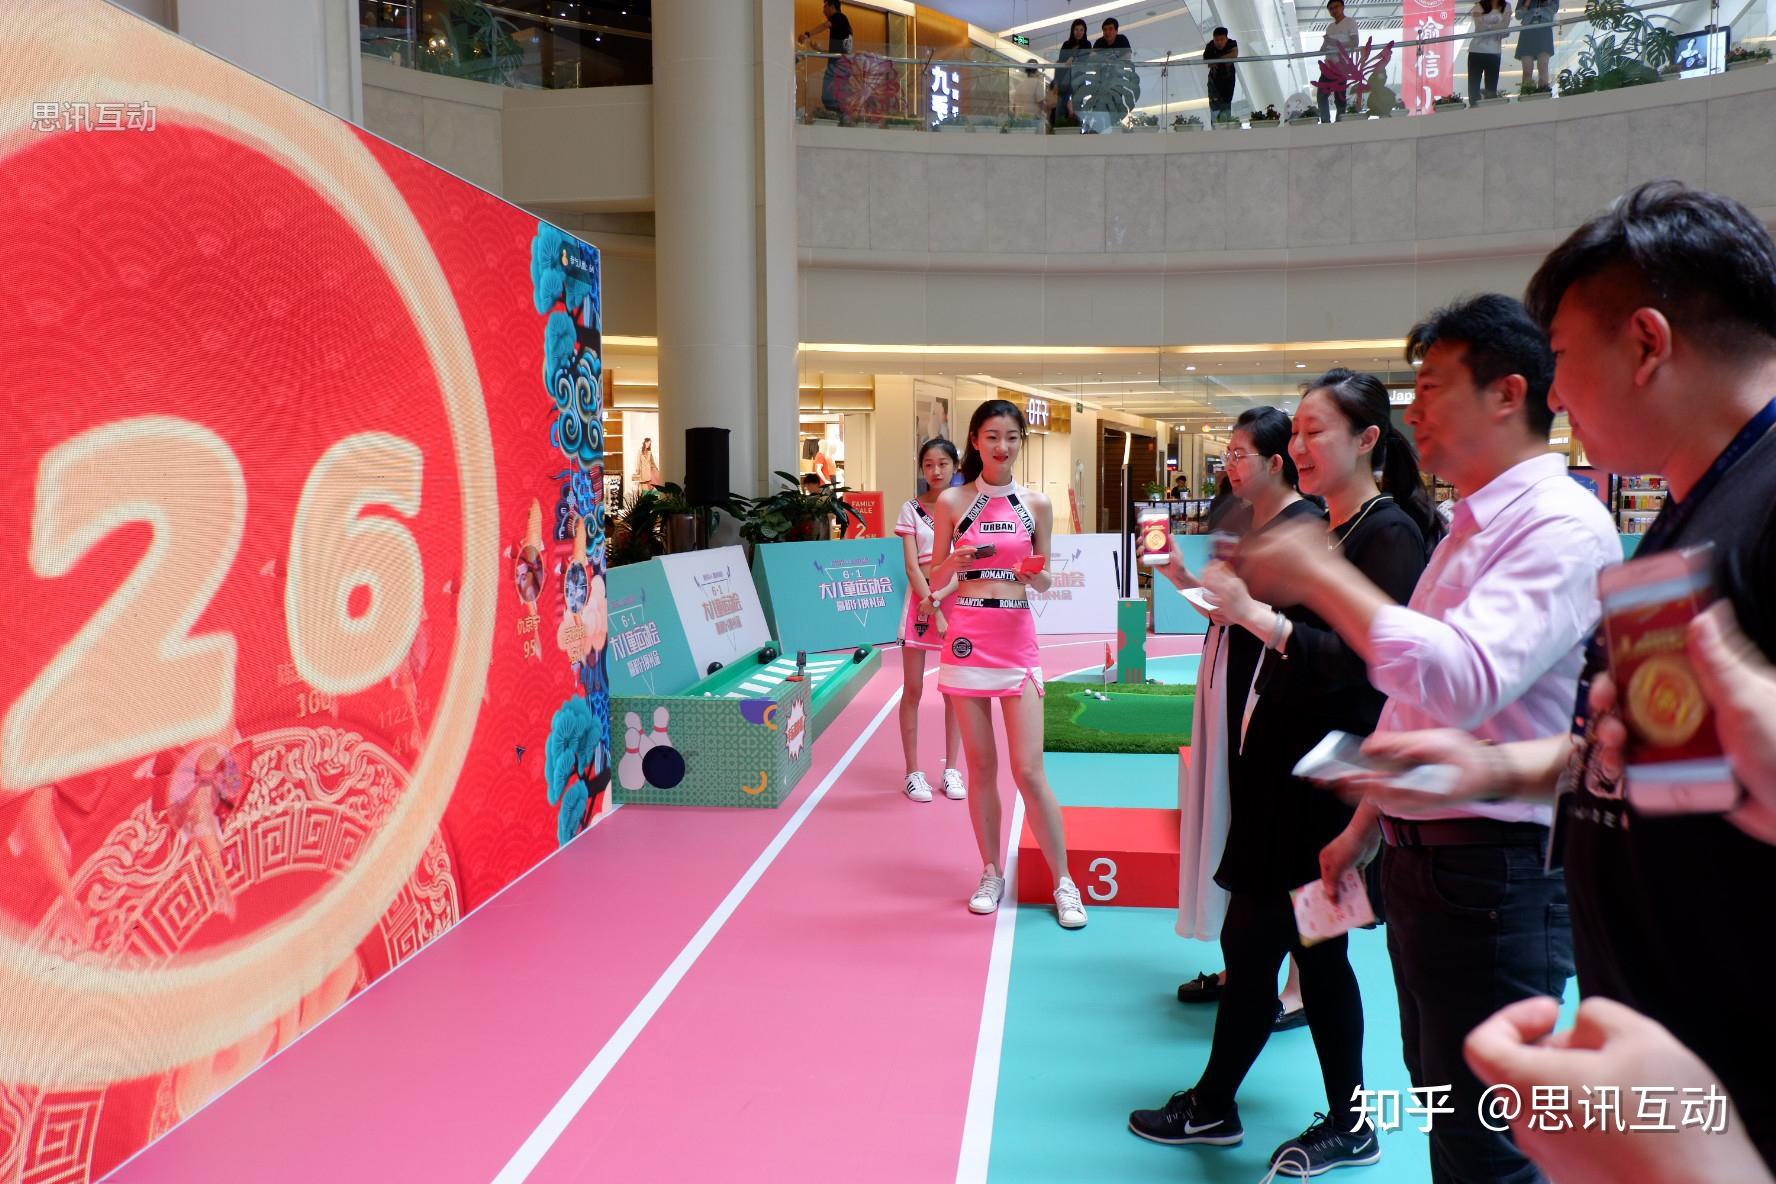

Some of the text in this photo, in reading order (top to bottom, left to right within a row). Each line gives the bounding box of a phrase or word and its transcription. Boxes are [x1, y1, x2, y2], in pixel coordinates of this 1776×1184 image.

[983, 522, 1013, 531] URBAN
[819, 577, 894, 600] 大儿童运动会
[609, 620, 662, 662] 大儿童运动会
[1088, 857, 1118, 901] 3
